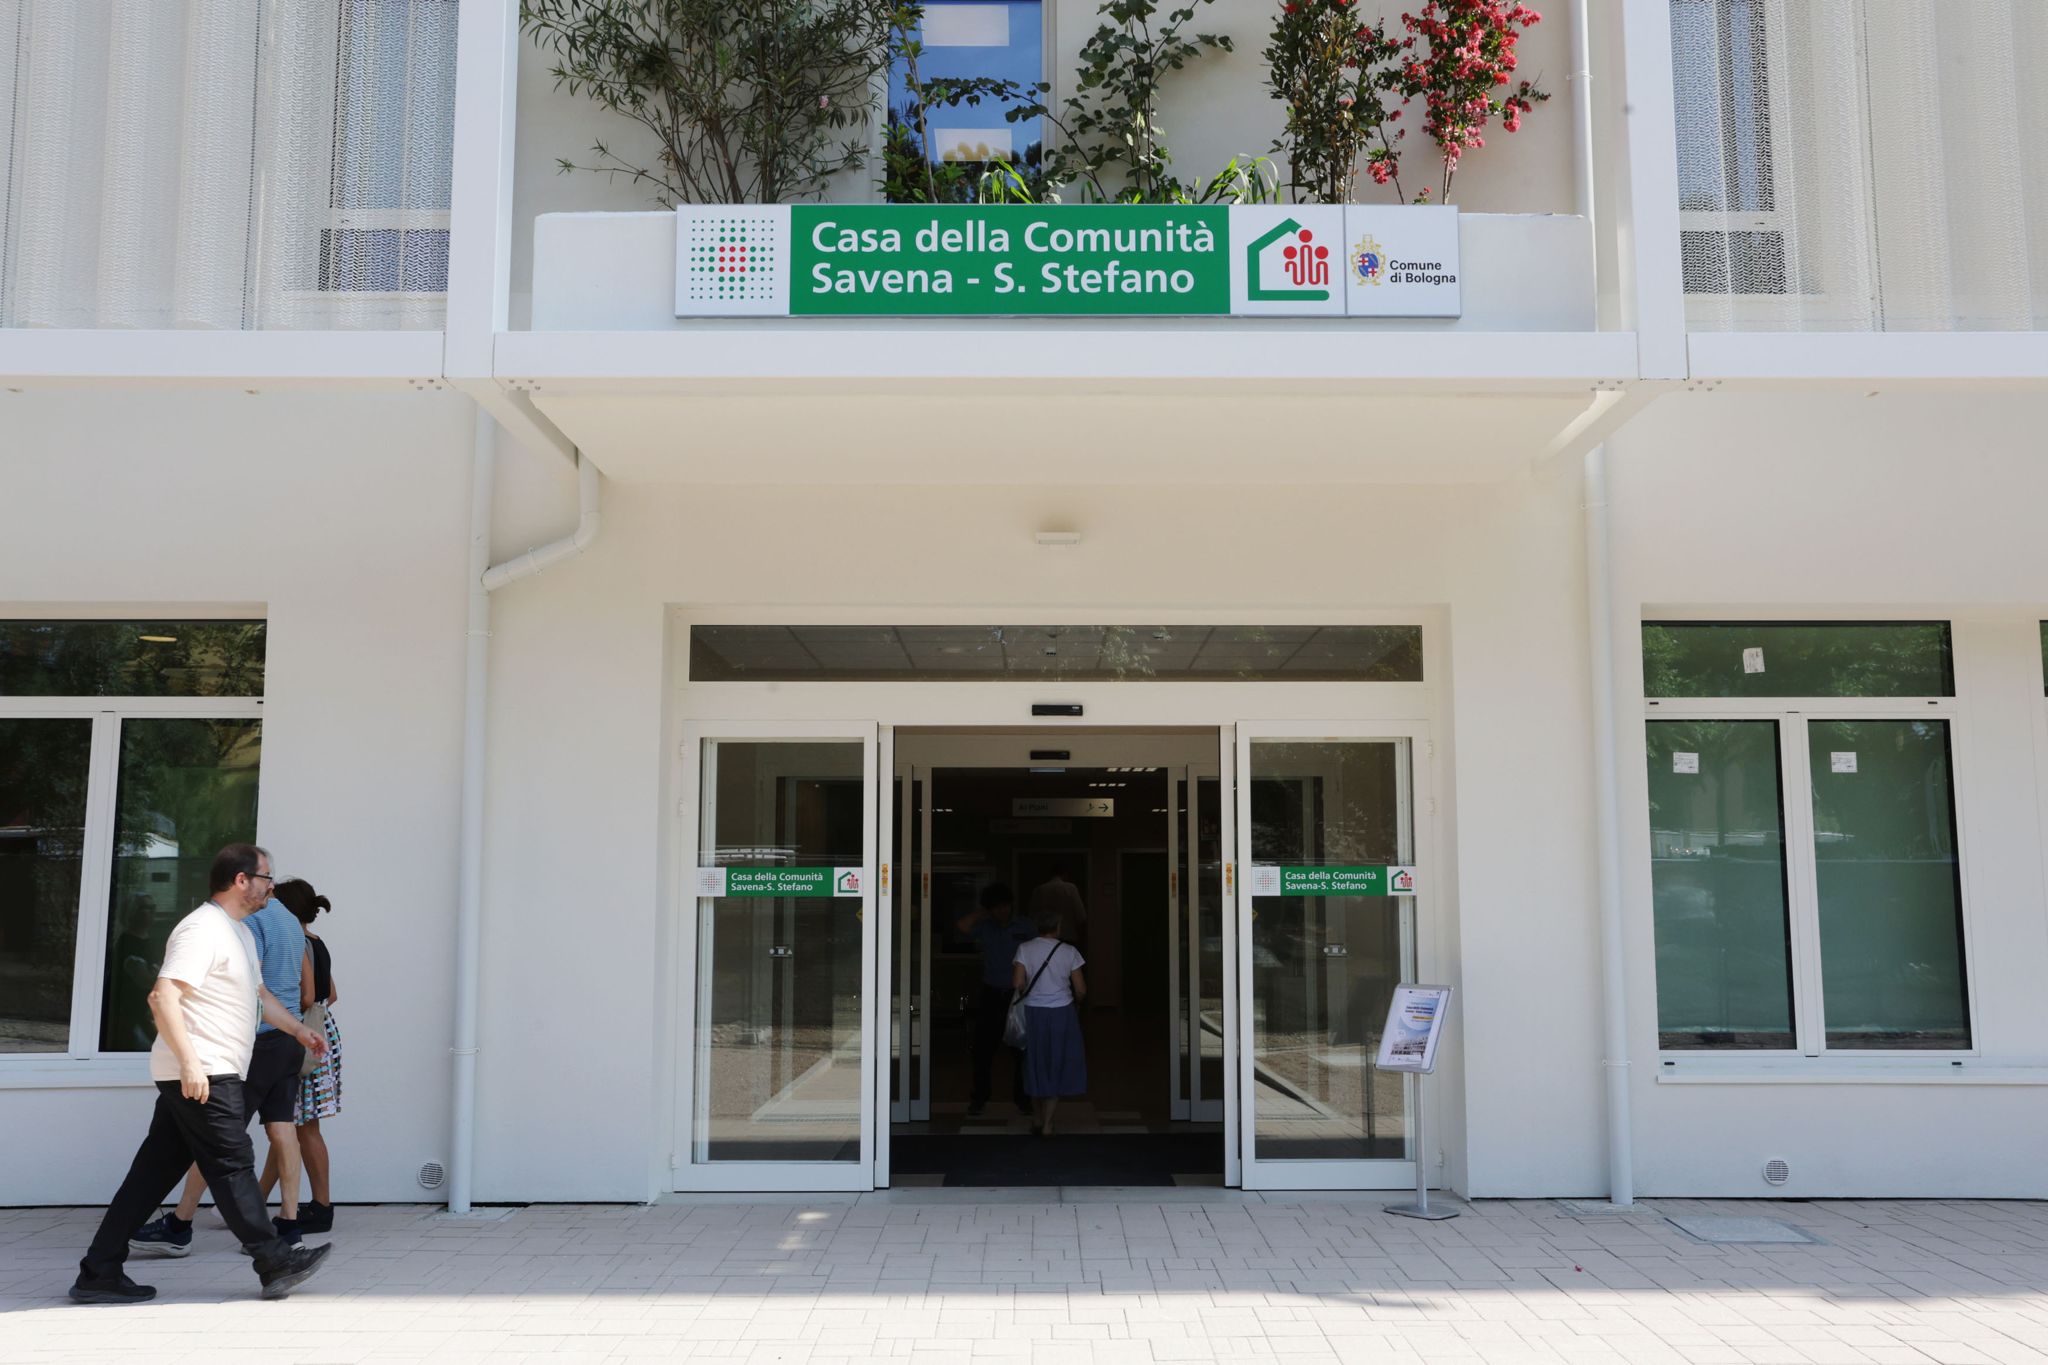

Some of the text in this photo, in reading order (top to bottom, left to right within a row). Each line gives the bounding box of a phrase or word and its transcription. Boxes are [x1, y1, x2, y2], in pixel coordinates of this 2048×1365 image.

[813, 220, 1214, 253] Casa della Comunità
[1389, 259, 1442, 271] Comune
[812, 262, 953, 294] Savena
[993, 262, 1026, 294] S.
[1041, 260, 1195, 294] Stefano
[1390, 272, 1456, 286] di Bologna
[731, 872, 824, 881] Casa della Comunità
[1285, 871, 1377, 880] Casa della Comunità
[777, 882, 813, 891] Stefano
[1331, 881, 1367, 890] Stefano
